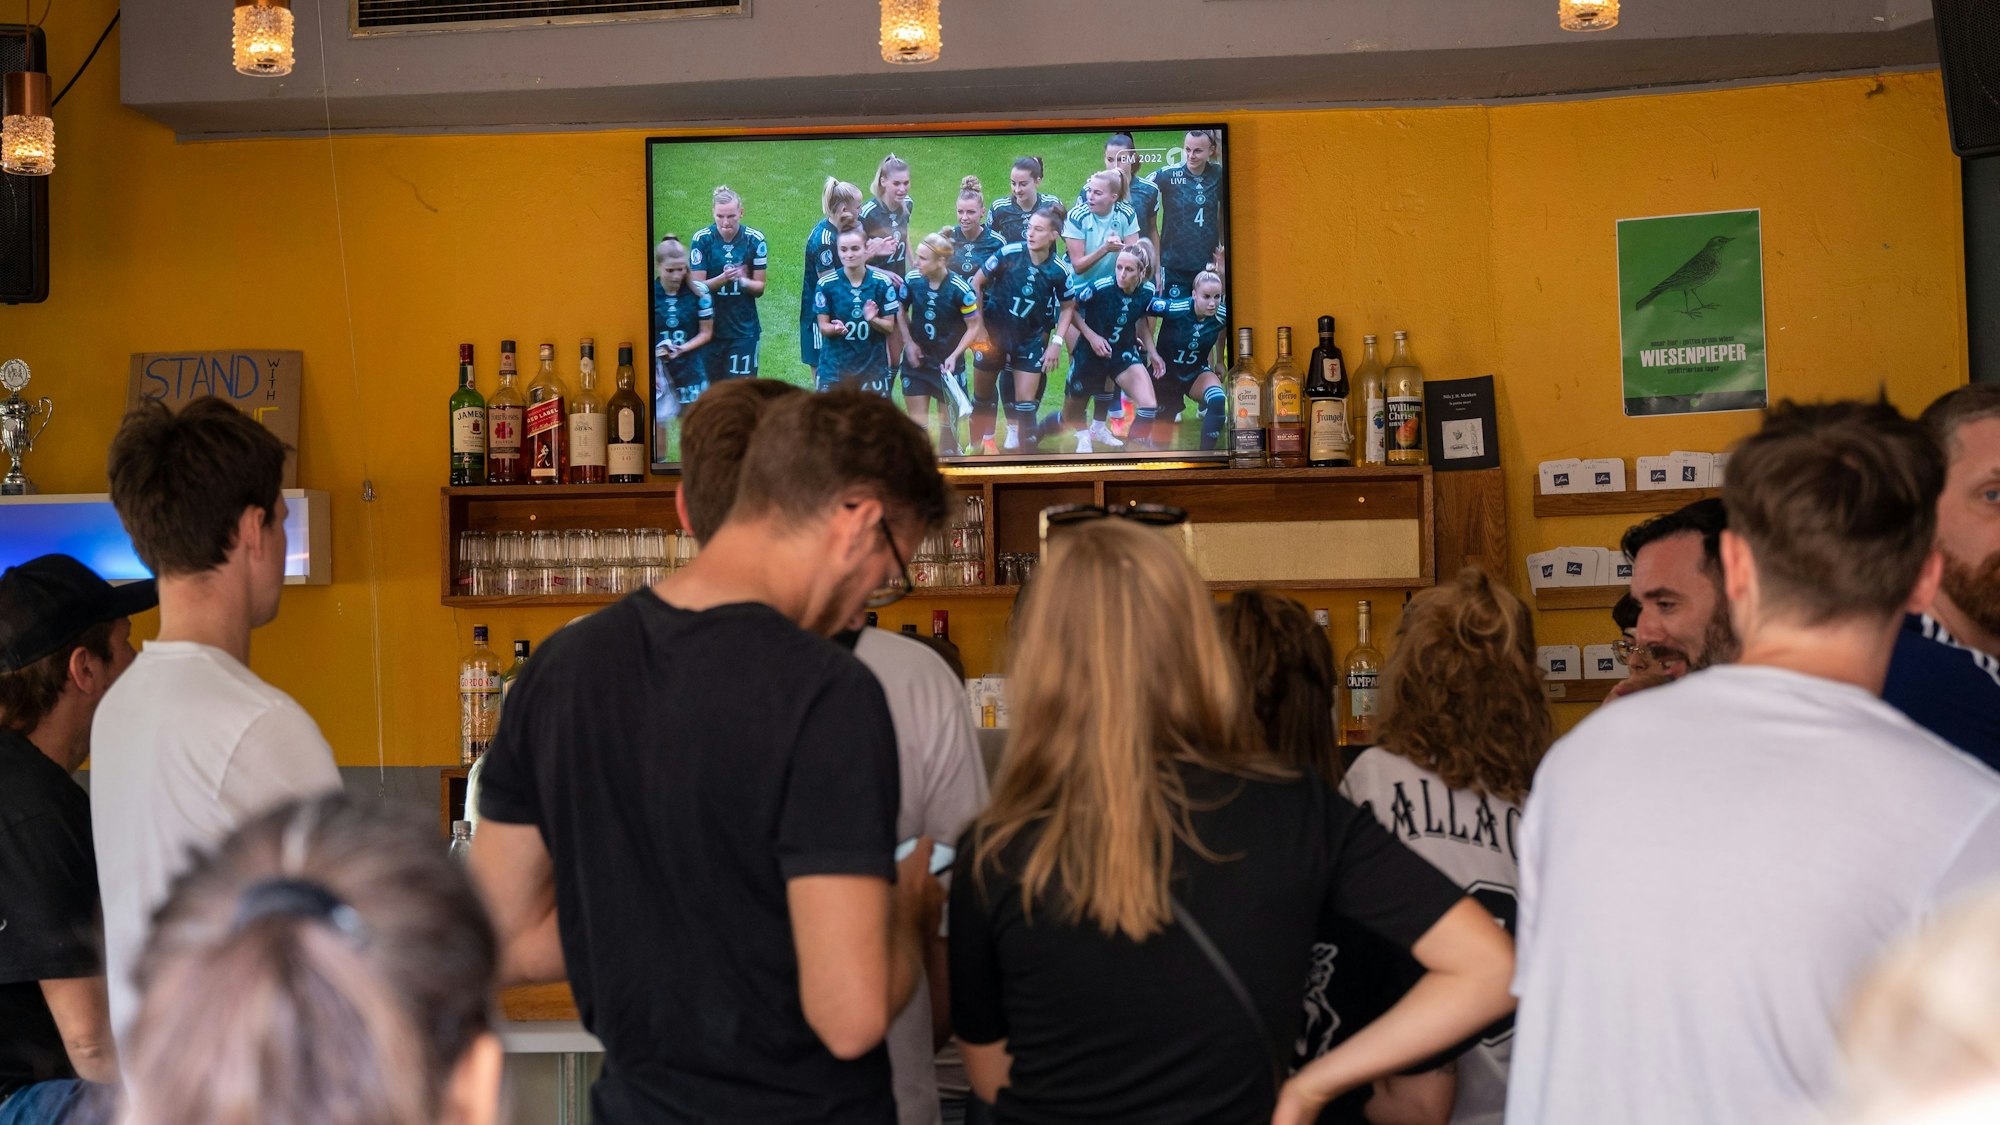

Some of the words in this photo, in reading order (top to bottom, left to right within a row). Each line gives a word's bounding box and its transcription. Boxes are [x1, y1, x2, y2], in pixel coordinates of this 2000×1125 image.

[1120, 154, 1136, 164] EM
[1138, 153, 1162, 164] 2022
[1170, 177, 1187, 185] LIVE
[1194, 208, 1205, 228] 4
[1008, 296, 1035, 319] 17
[845, 321, 869, 341] 20
[924, 324, 936, 340] 9
[1108, 326, 1124, 343] 3
[1173, 349, 1200, 365] 15
[1640, 343, 1746, 367] WIESENPIEPER
[729, 354, 751, 375] 11
[145, 354, 259, 401] STAND
[266, 358, 281, 401] WITH
[1237, 392, 1257, 401] Cuervo
[1277, 392, 1297, 401] Cuervo
[457, 410, 485, 421] JAMES
[527, 415, 539, 423] RED
[539, 408, 559, 418] LABEL
[1315, 409, 1344, 424] Frangeli
